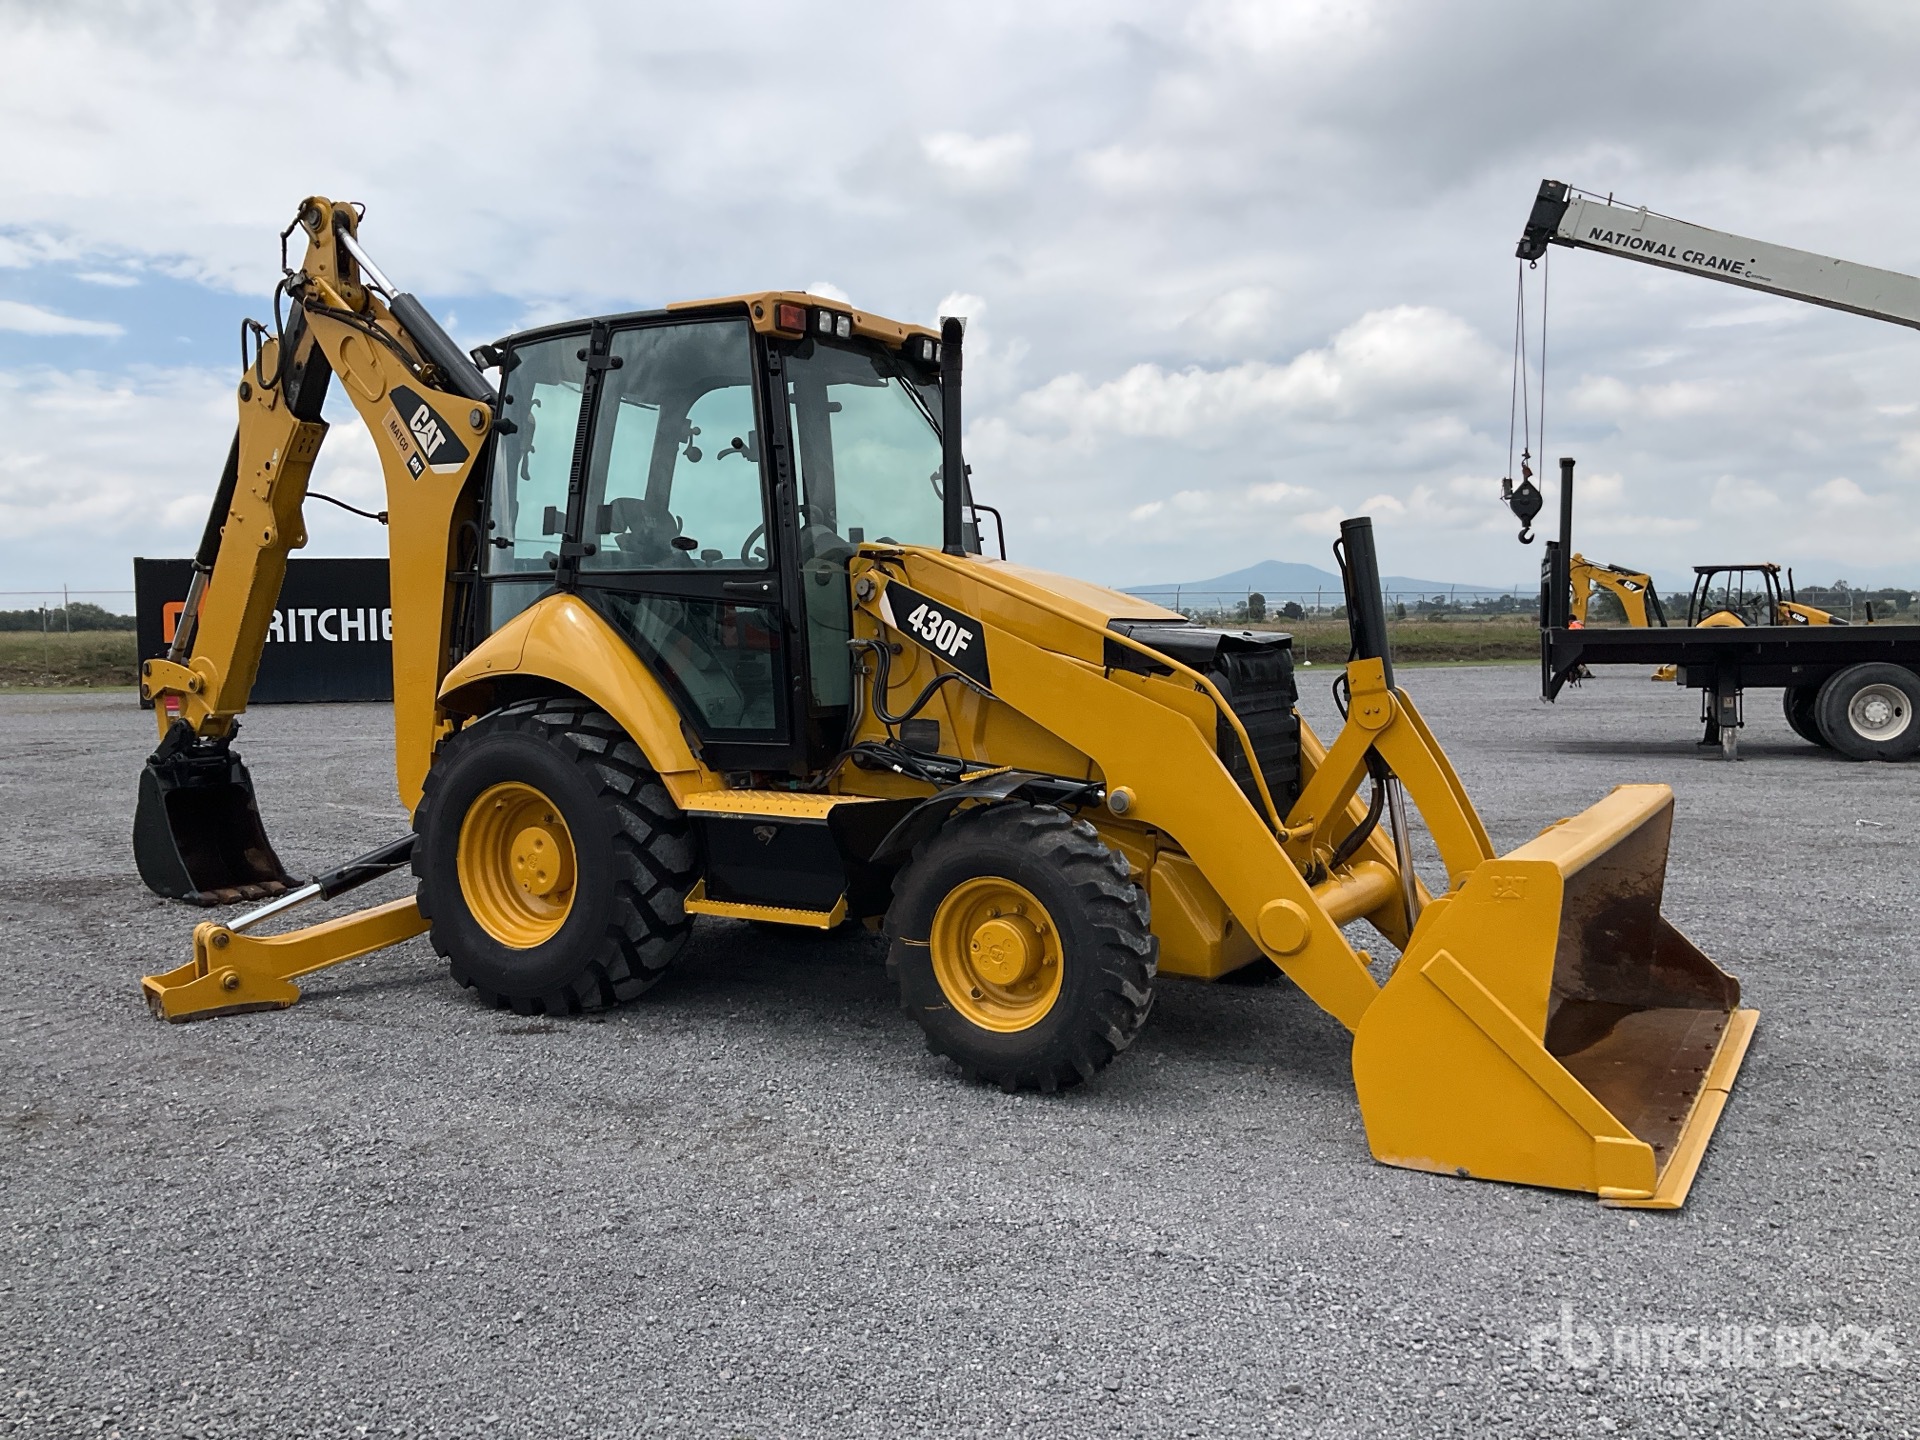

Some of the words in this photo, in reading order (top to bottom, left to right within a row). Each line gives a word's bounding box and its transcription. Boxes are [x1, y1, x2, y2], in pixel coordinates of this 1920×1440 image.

[1588, 227, 1676, 259] NATIONAL
[1682, 249, 1745, 275] CRANE
[389, 420, 409, 452] MATCO
[409, 456, 422, 475] CAT
[409, 404, 447, 459] CAT
[907, 603, 974, 658] 430F
